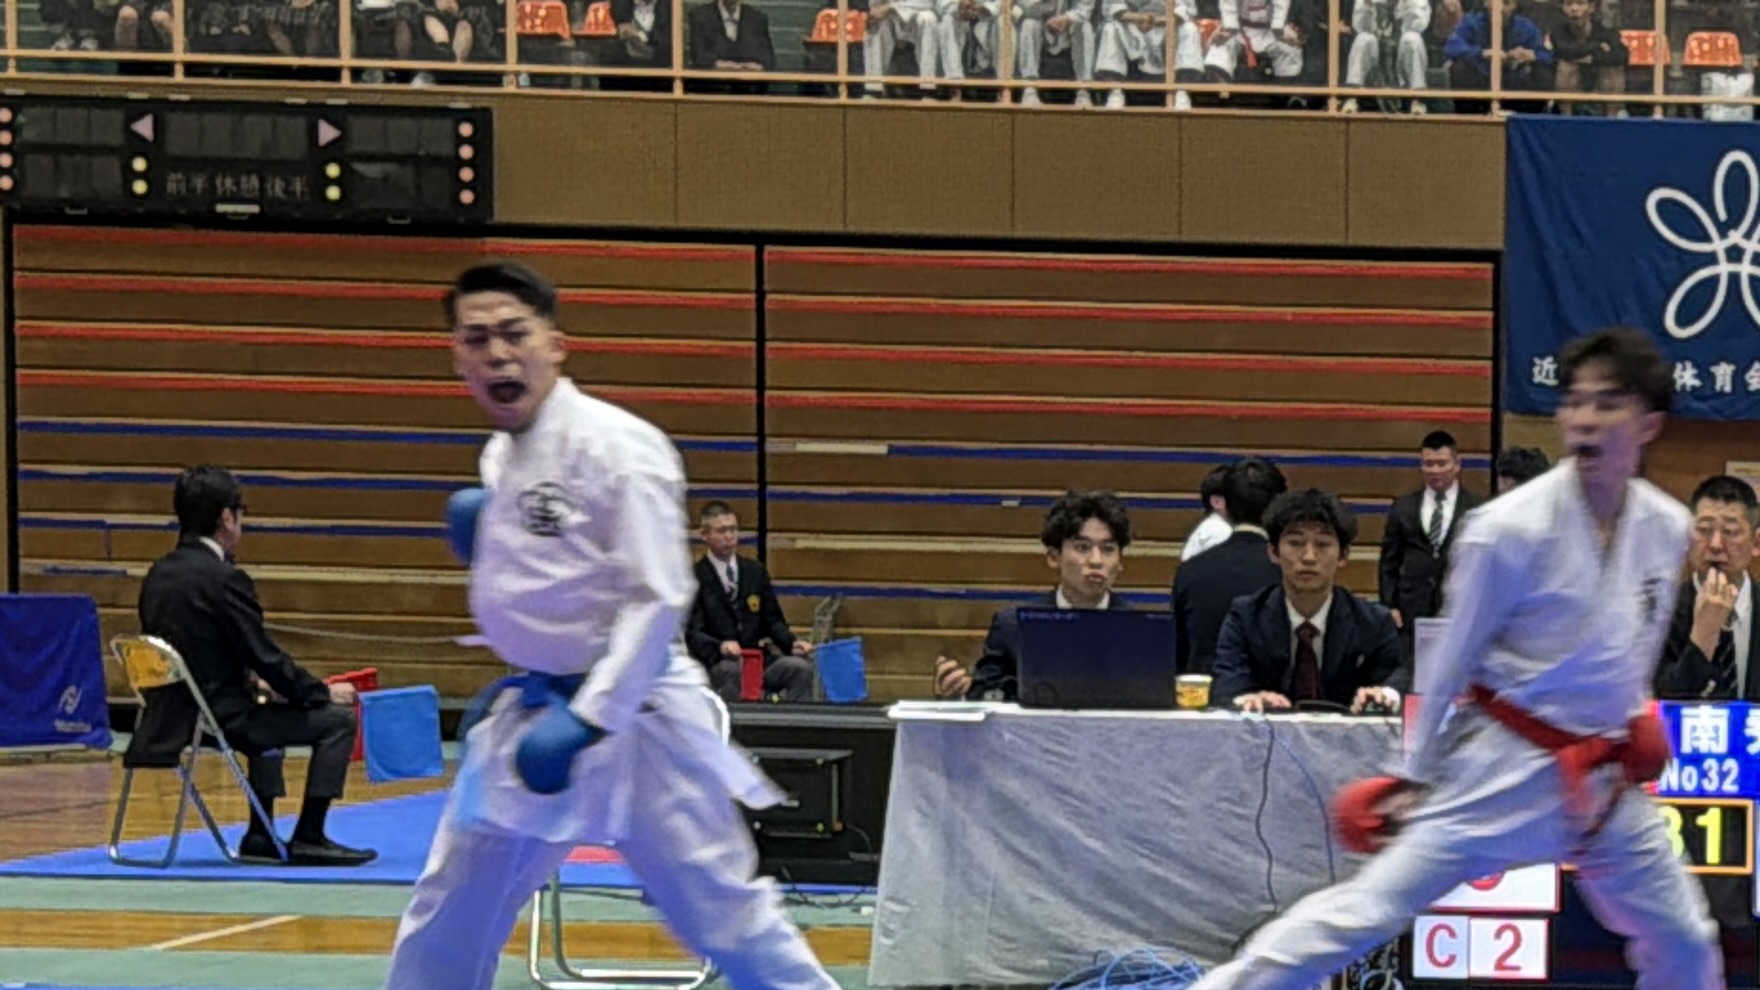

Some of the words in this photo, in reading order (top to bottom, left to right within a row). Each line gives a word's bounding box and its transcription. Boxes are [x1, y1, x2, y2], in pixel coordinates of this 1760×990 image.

[1680, 706, 1729, 754] 南
[1425, 923, 1457, 968] C
[1494, 923, 1522, 971] 2
